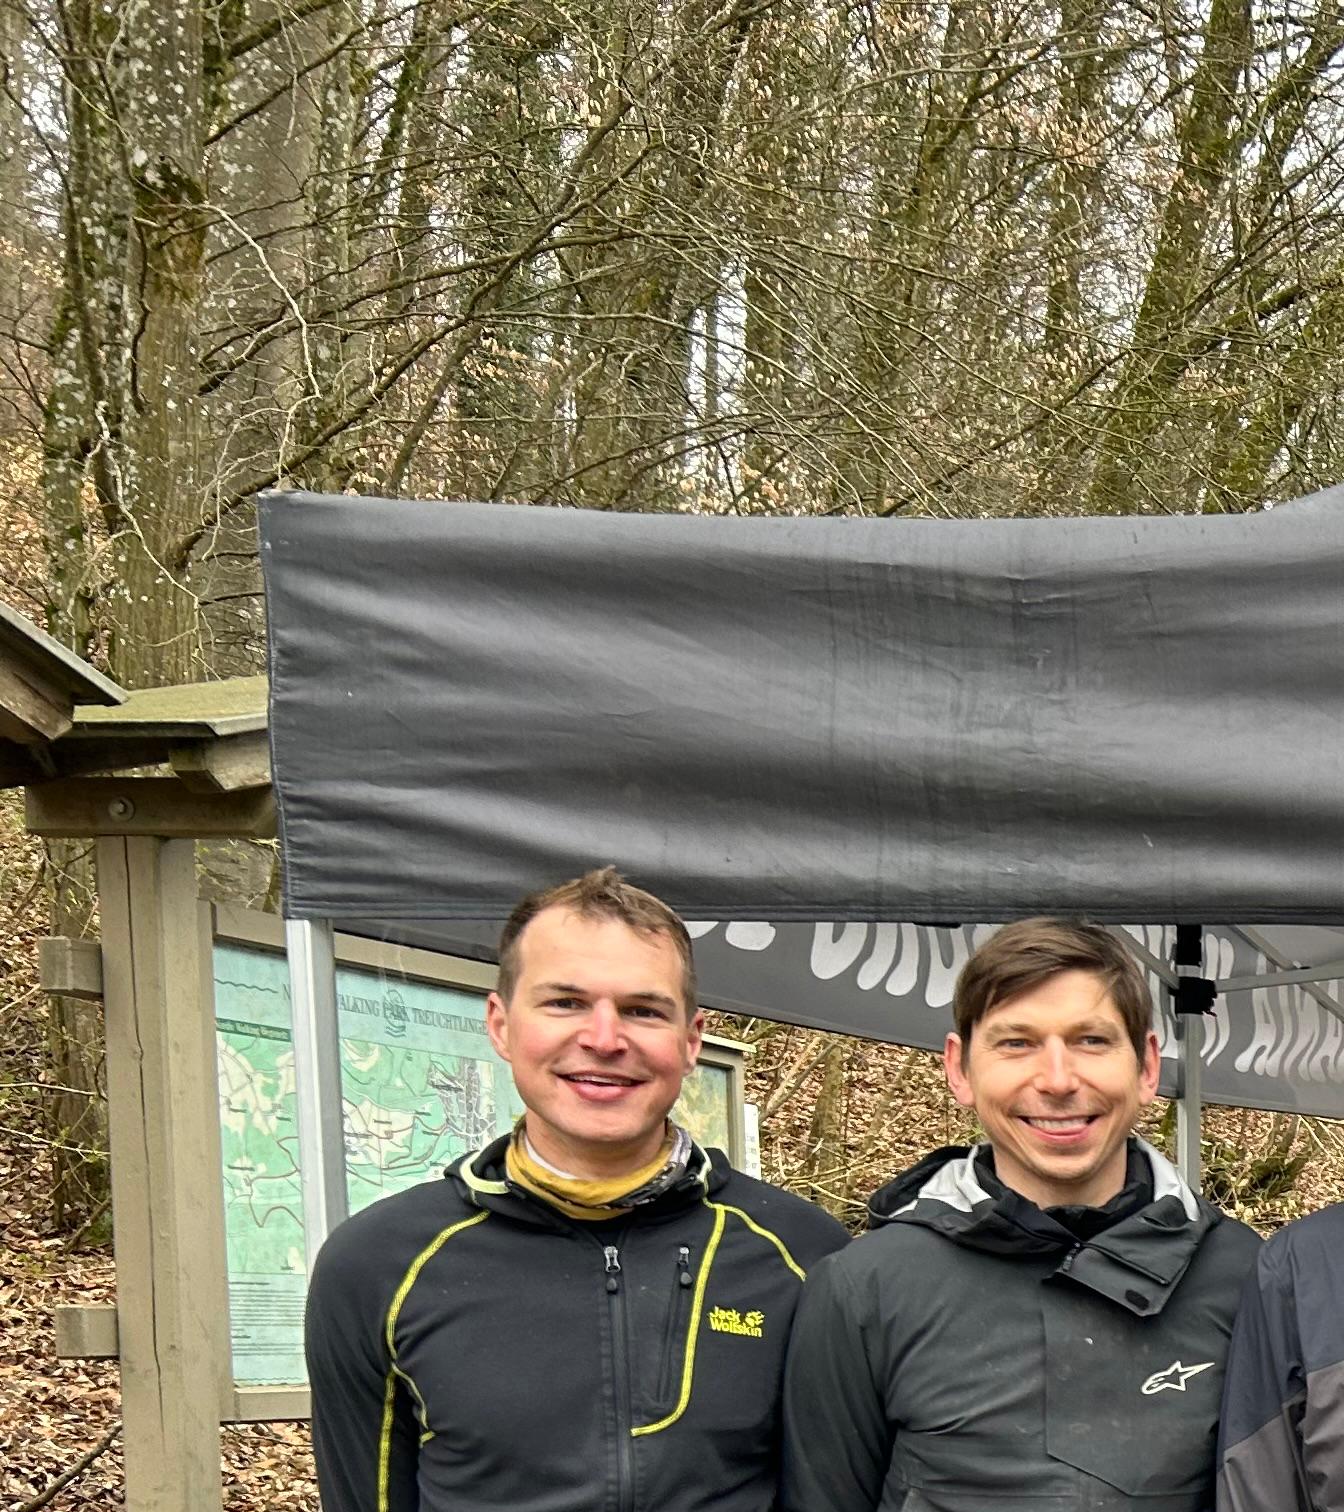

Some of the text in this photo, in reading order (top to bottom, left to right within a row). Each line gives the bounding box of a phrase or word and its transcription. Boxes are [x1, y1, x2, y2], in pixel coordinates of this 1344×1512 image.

[336, 993, 381, 1017] ALKING
[411, 1007, 489, 1035] TREUCHTLINGE
[709, 1305, 741, 1322] Jack
[710, 1317, 763, 1338] Wolfskin
